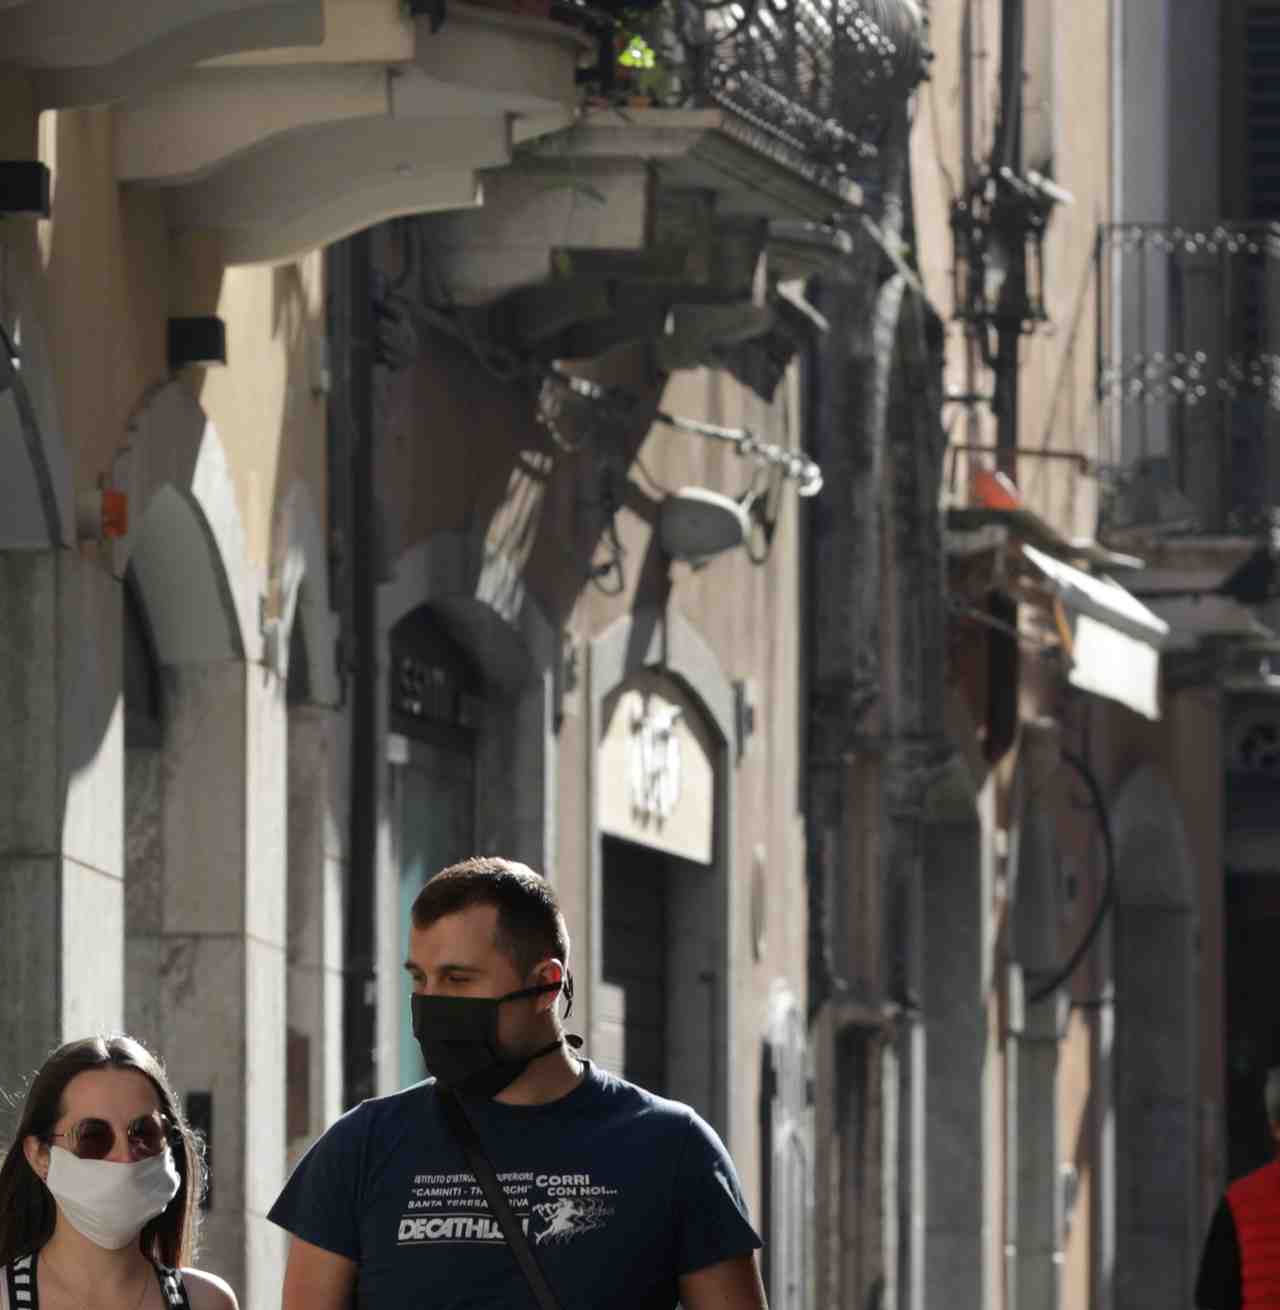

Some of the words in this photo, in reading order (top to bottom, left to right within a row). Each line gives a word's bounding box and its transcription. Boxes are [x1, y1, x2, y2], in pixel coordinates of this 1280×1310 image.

[496, 1172, 534, 1183] UPERIORE
[535, 1174, 590, 1187] CORRI
[547, 1186, 577, 1197] CON
[407, 1200, 443, 1209] SANTA
[398, 1217, 529, 1241] DECATHL
